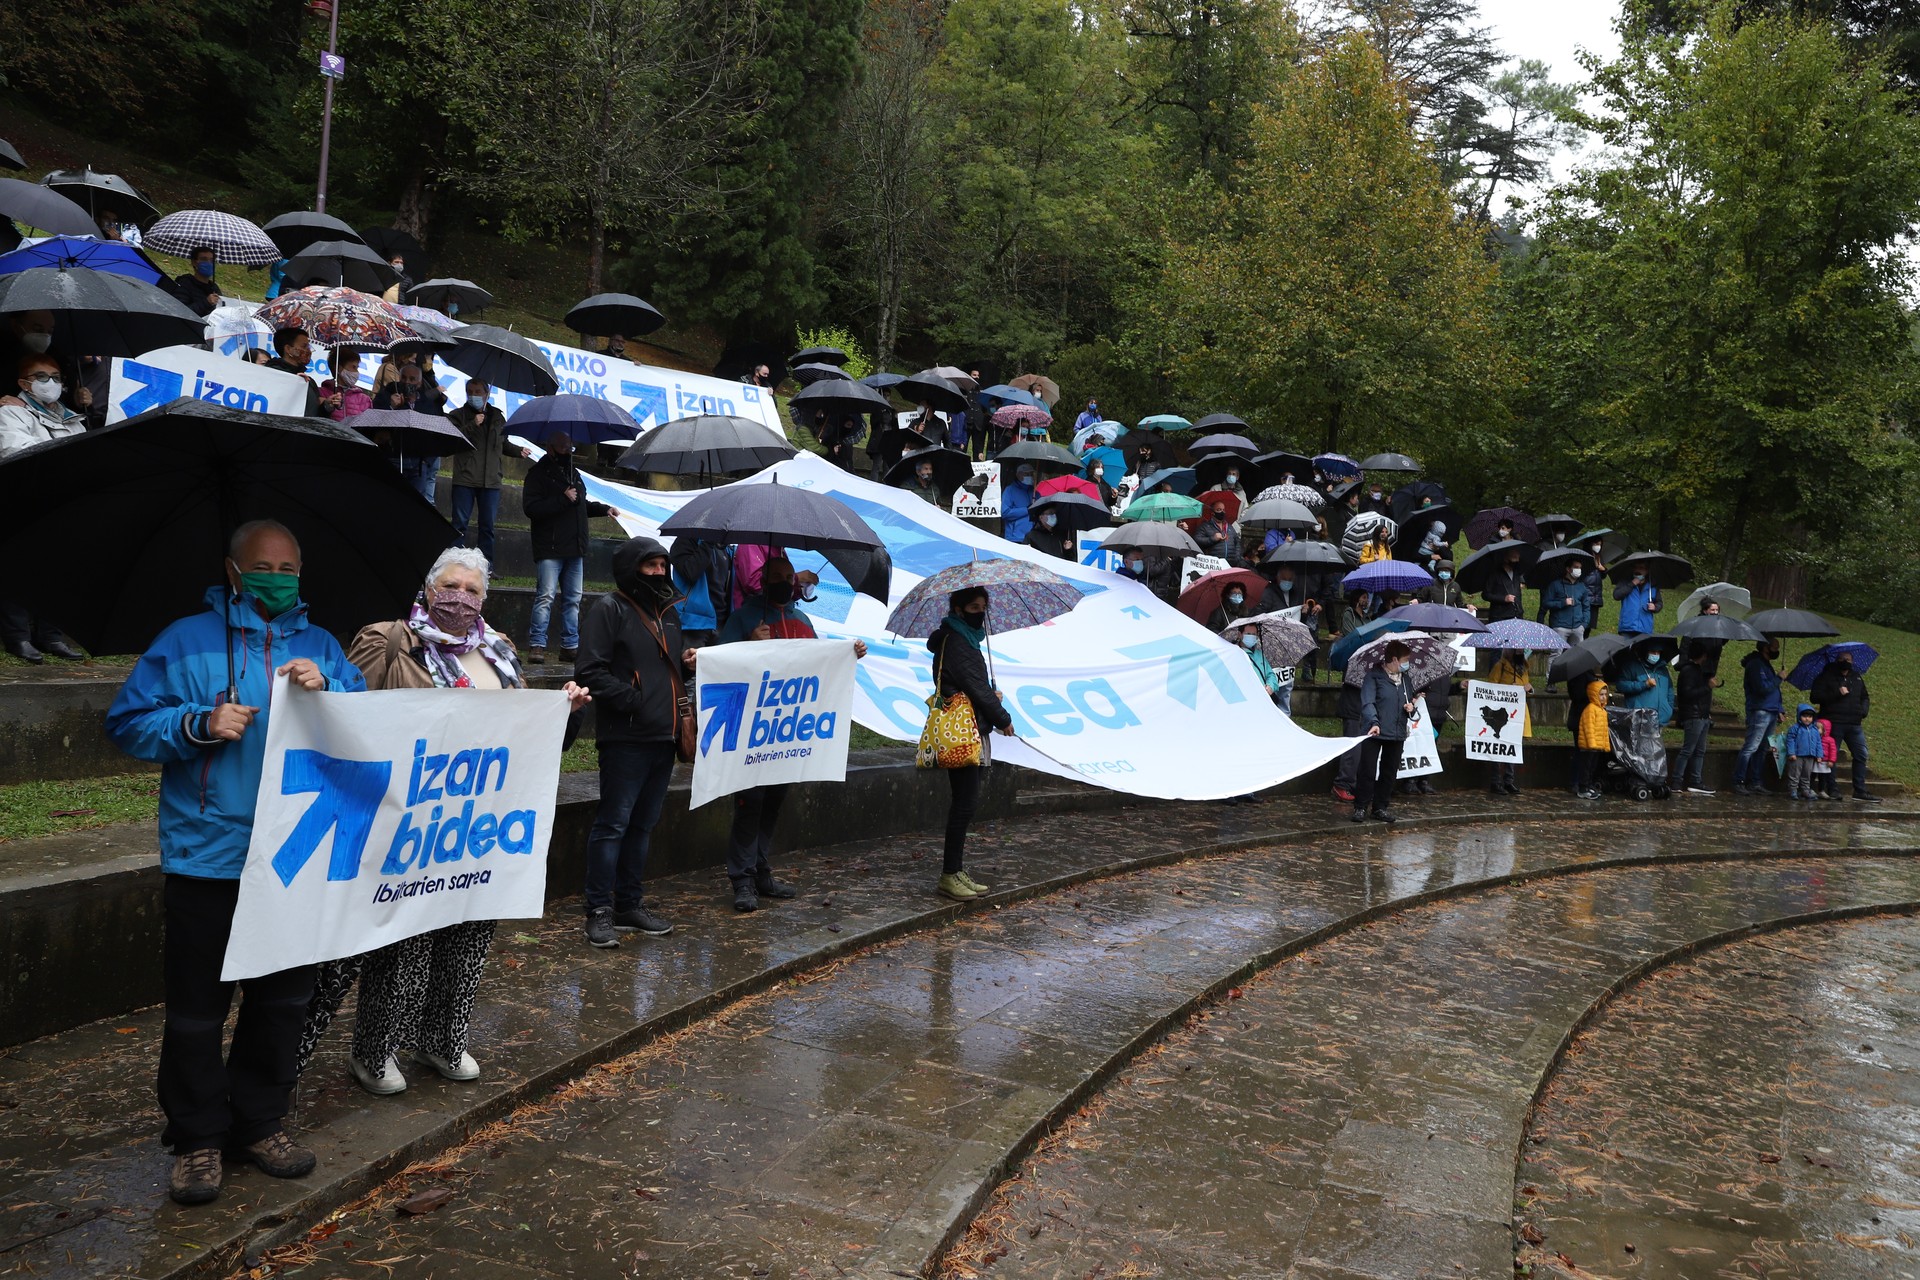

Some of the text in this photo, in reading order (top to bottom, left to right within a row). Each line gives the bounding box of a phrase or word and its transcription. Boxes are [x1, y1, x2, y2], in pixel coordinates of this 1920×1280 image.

[193, 369, 269, 414] izan
[556, 375, 609, 401] SOAK
[674, 383, 736, 417] izan
[956, 506, 998, 516] ETXERA
[756, 670, 820, 708] izan
[1473, 692, 1484, 700] ETA
[1475, 686, 1518, 698] EUSKAL PRESO
[747, 707, 837, 749] bidea
[744, 747, 812, 766] Ibiltarien sarea
[1399, 755, 1432, 771] ERA
[1471, 740, 1517, 757] ETXERA
[406, 738, 510, 808] izan
[380, 799, 537, 876] bidea
[372, 869, 492, 905] Ibiltarien sarea
